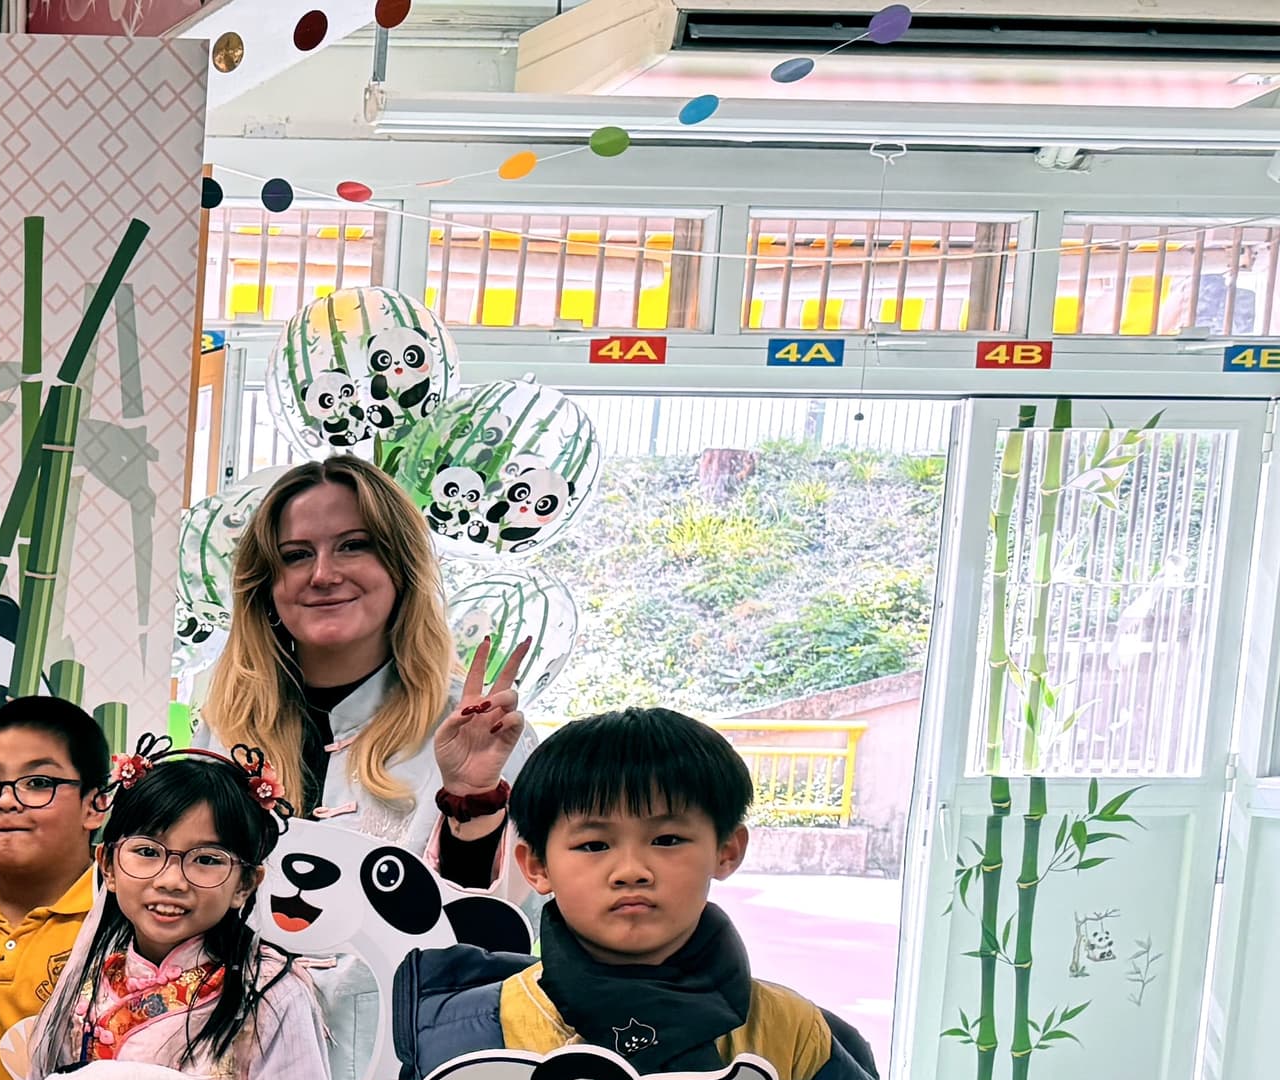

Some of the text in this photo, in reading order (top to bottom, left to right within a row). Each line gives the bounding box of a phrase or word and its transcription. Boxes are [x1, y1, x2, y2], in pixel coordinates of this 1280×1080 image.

[597, 339, 659, 361] 4A
[774, 342, 836, 363] 4A
[984, 343, 1043, 365] 4B
